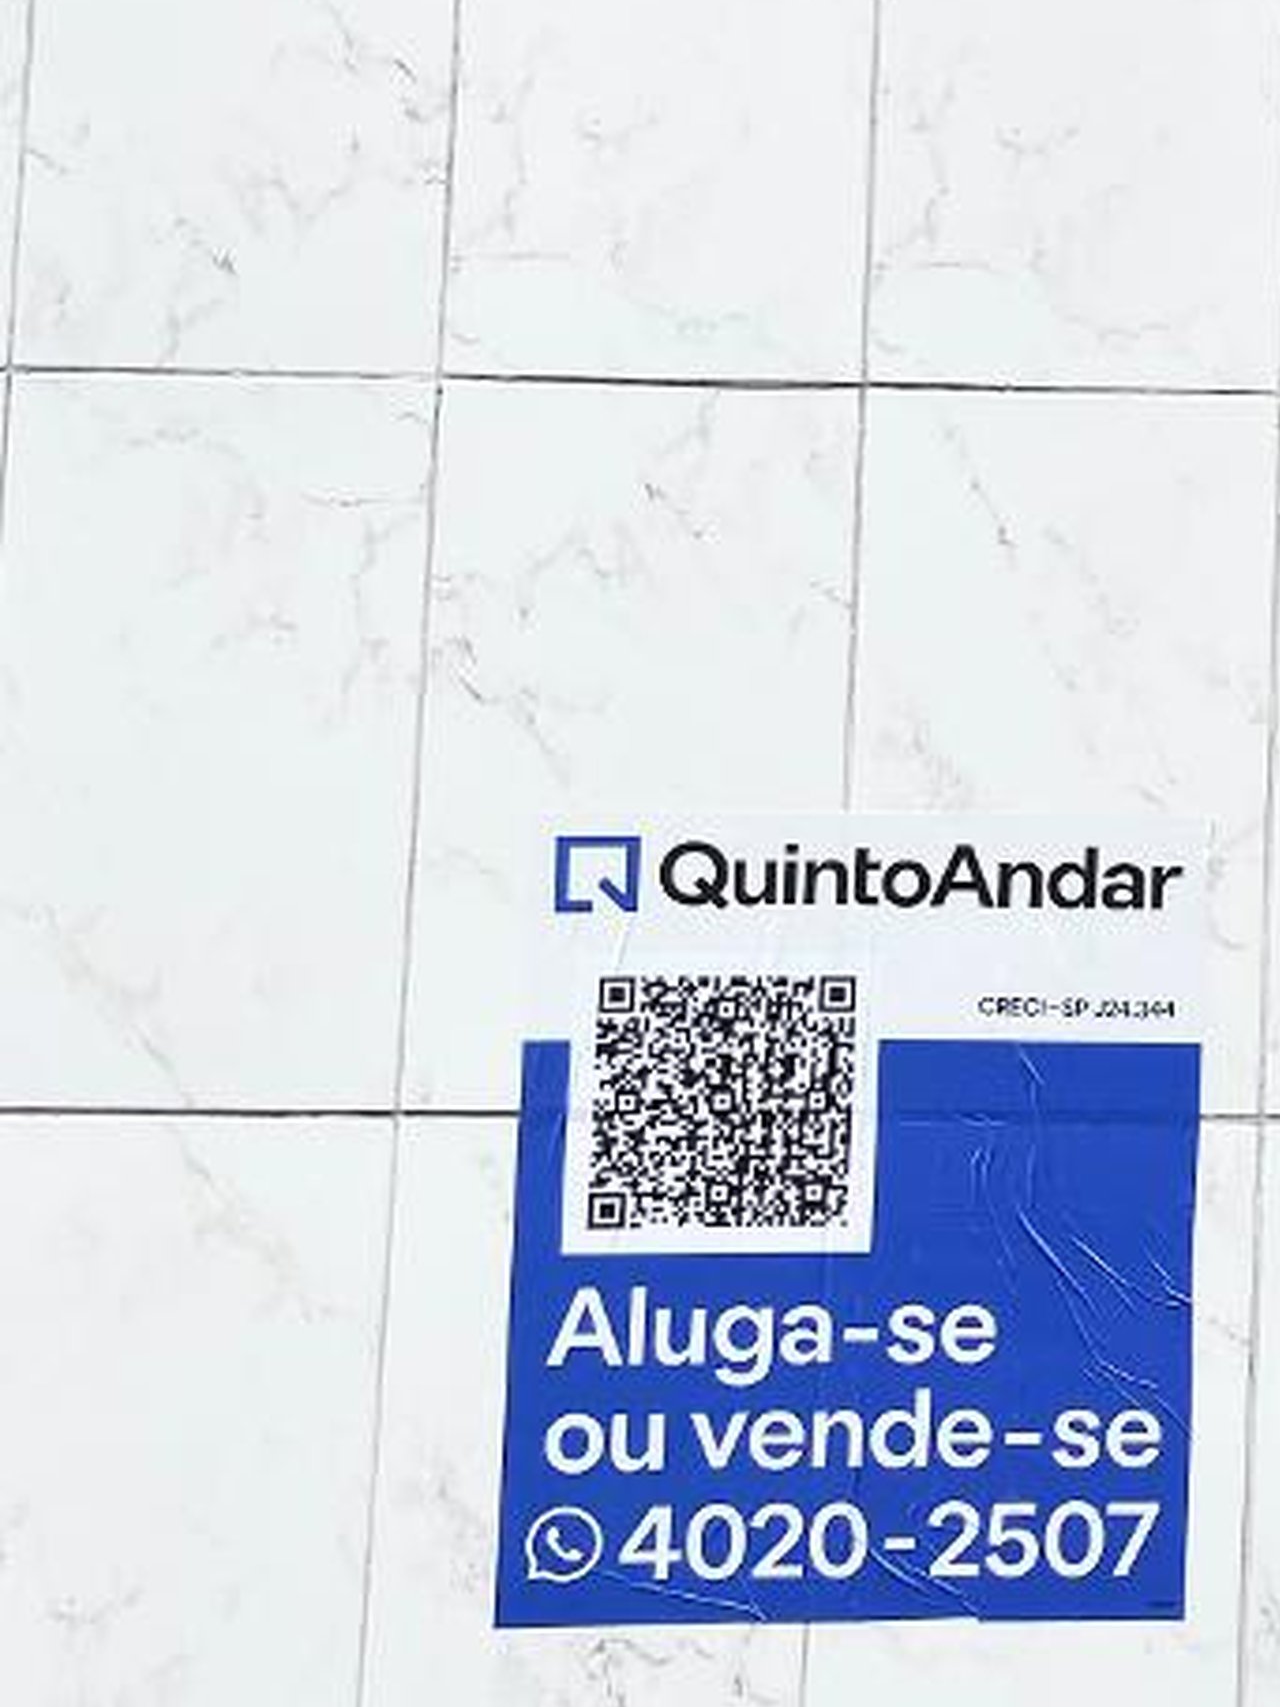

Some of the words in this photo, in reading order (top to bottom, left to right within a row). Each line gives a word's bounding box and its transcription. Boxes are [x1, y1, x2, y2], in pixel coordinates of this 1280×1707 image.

[658, 840, 1184, 910] QuintoAndar
[977, 996, 1090, 1018] CRECI-SP
[545, 1286, 997, 1385] Aluga-se
[544, 1412, 665, 1475] ou
[689, 1389, 1162, 1472] vende-se
[618, 1502, 1160, 1581] 4020-2507
